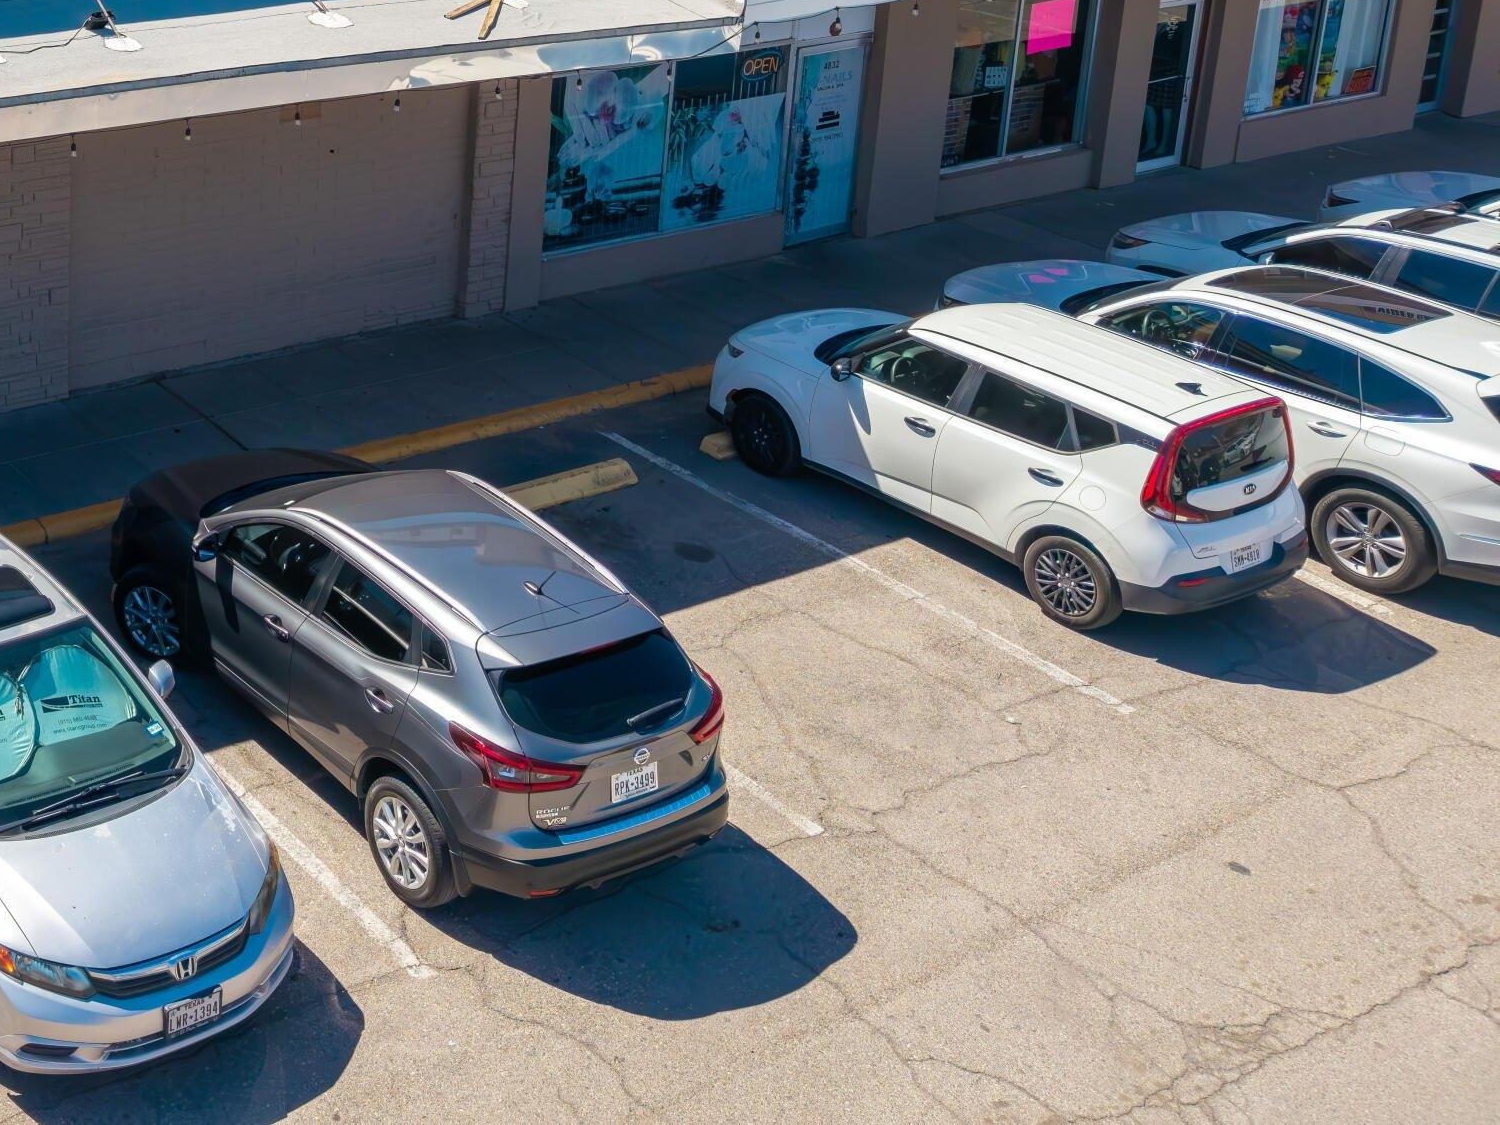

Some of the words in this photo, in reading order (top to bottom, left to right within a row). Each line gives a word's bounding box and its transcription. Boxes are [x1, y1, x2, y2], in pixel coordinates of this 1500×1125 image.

[743, 56, 779, 75] OPEN
[69, 695, 102, 704] Titan
[627, 767, 644, 776] TEXAS
[184, 998, 205, 1010] TEXAS
